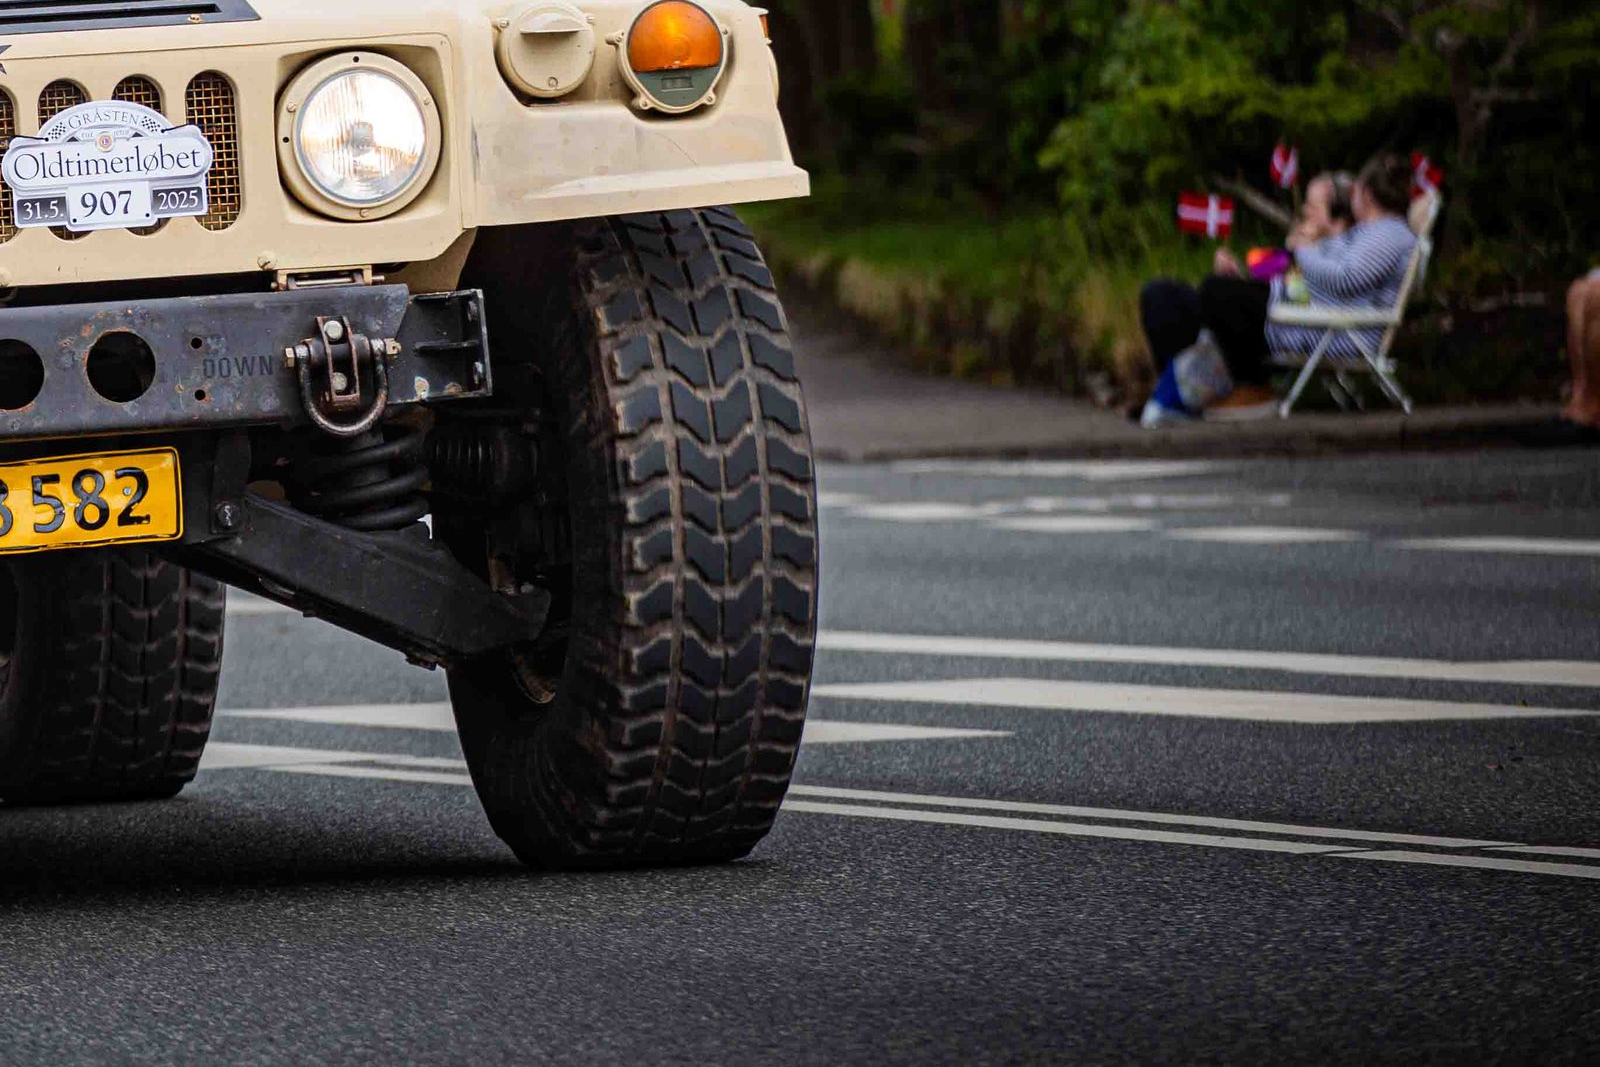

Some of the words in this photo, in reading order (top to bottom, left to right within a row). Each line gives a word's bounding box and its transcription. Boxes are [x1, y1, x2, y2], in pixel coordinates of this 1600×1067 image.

[14, 144, 200, 181] Oldtimerløbet
[23, 200, 64, 221] 31.5.
[80, 190, 132, 219] 907
[157, 188, 199, 211] 2025
[201, 355, 275, 379] DOWN
[31, 467, 152, 534] 582
